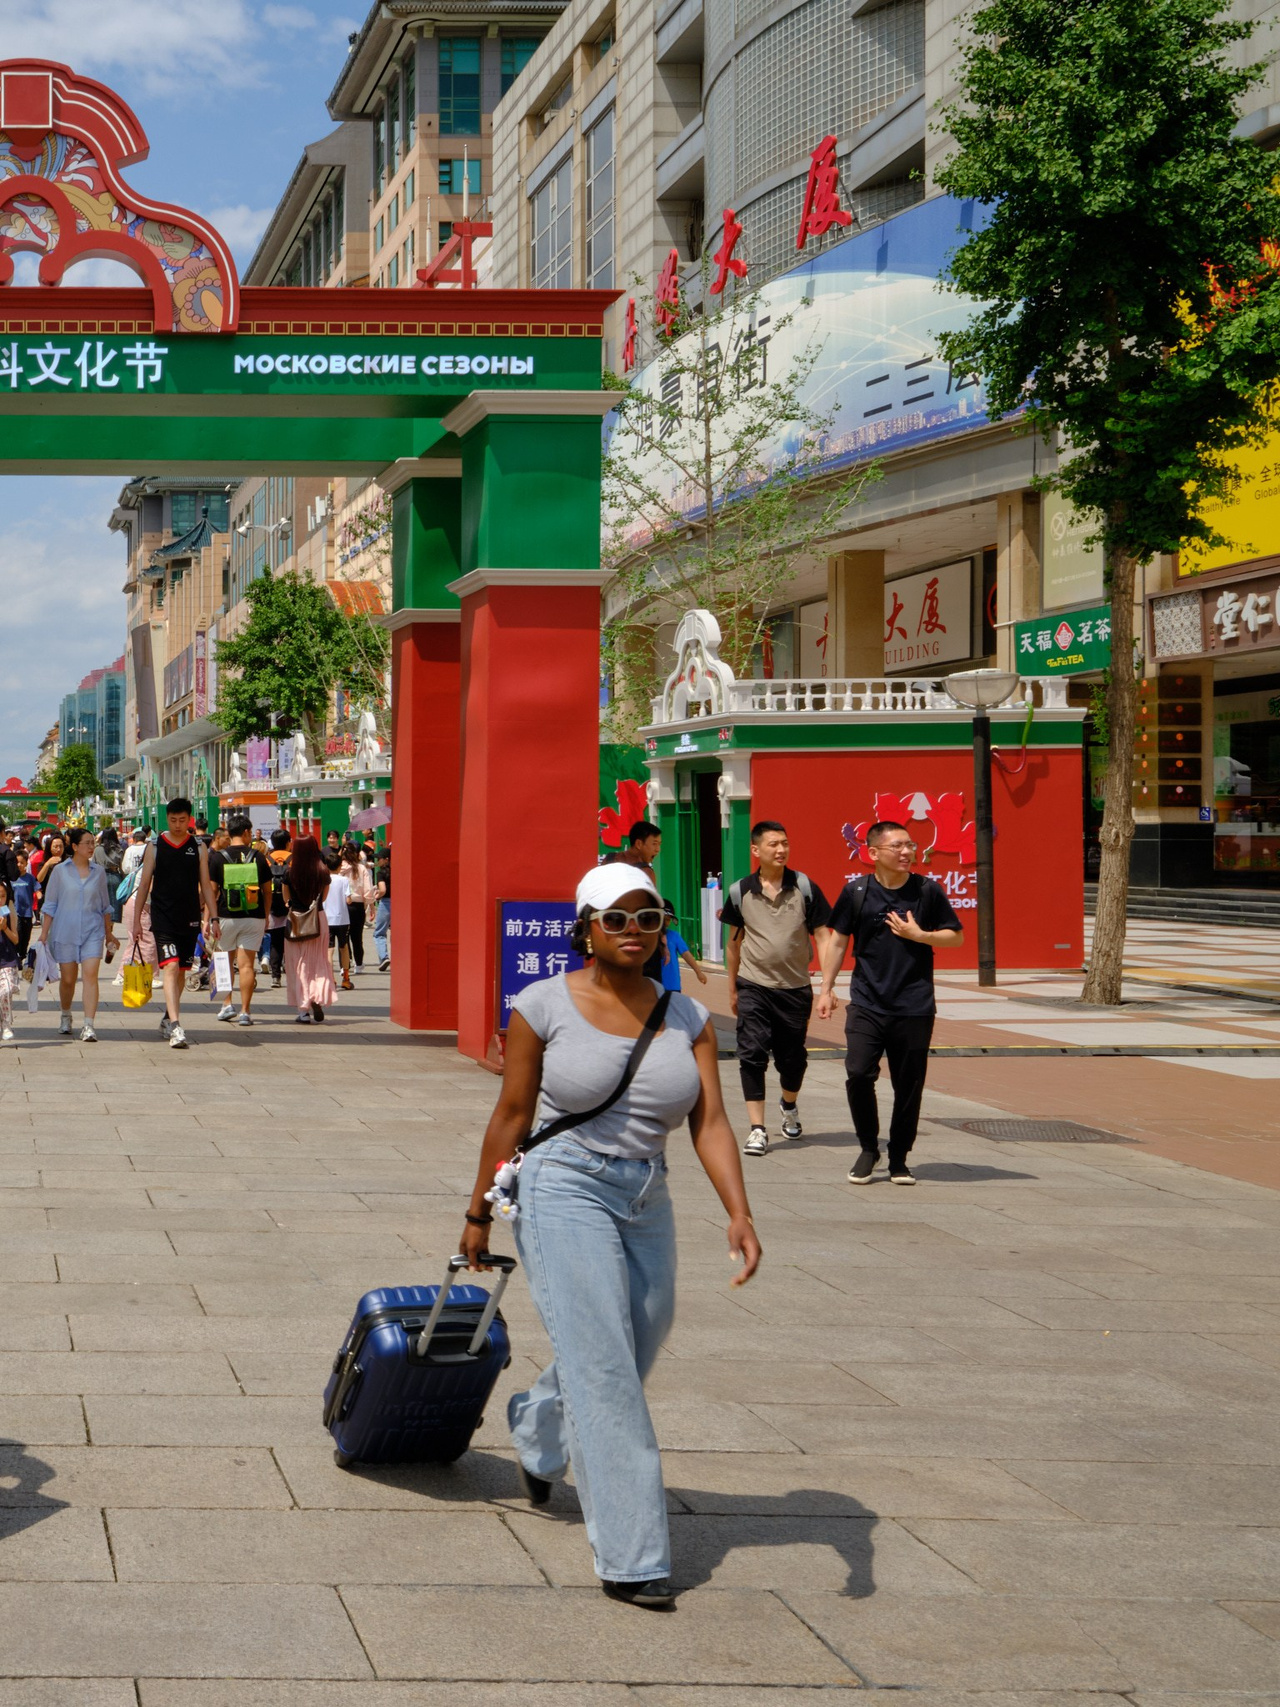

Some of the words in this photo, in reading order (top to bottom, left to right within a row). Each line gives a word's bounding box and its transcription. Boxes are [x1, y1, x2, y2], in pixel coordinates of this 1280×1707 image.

[233, 354, 417, 374] МОСКОВСКИЕ
[421, 355, 534, 375] СЕЗОНЫ
[885, 640, 940, 665] UILDING
[162, 943, 178, 959] 10
[517, 952, 569, 975] 通行
